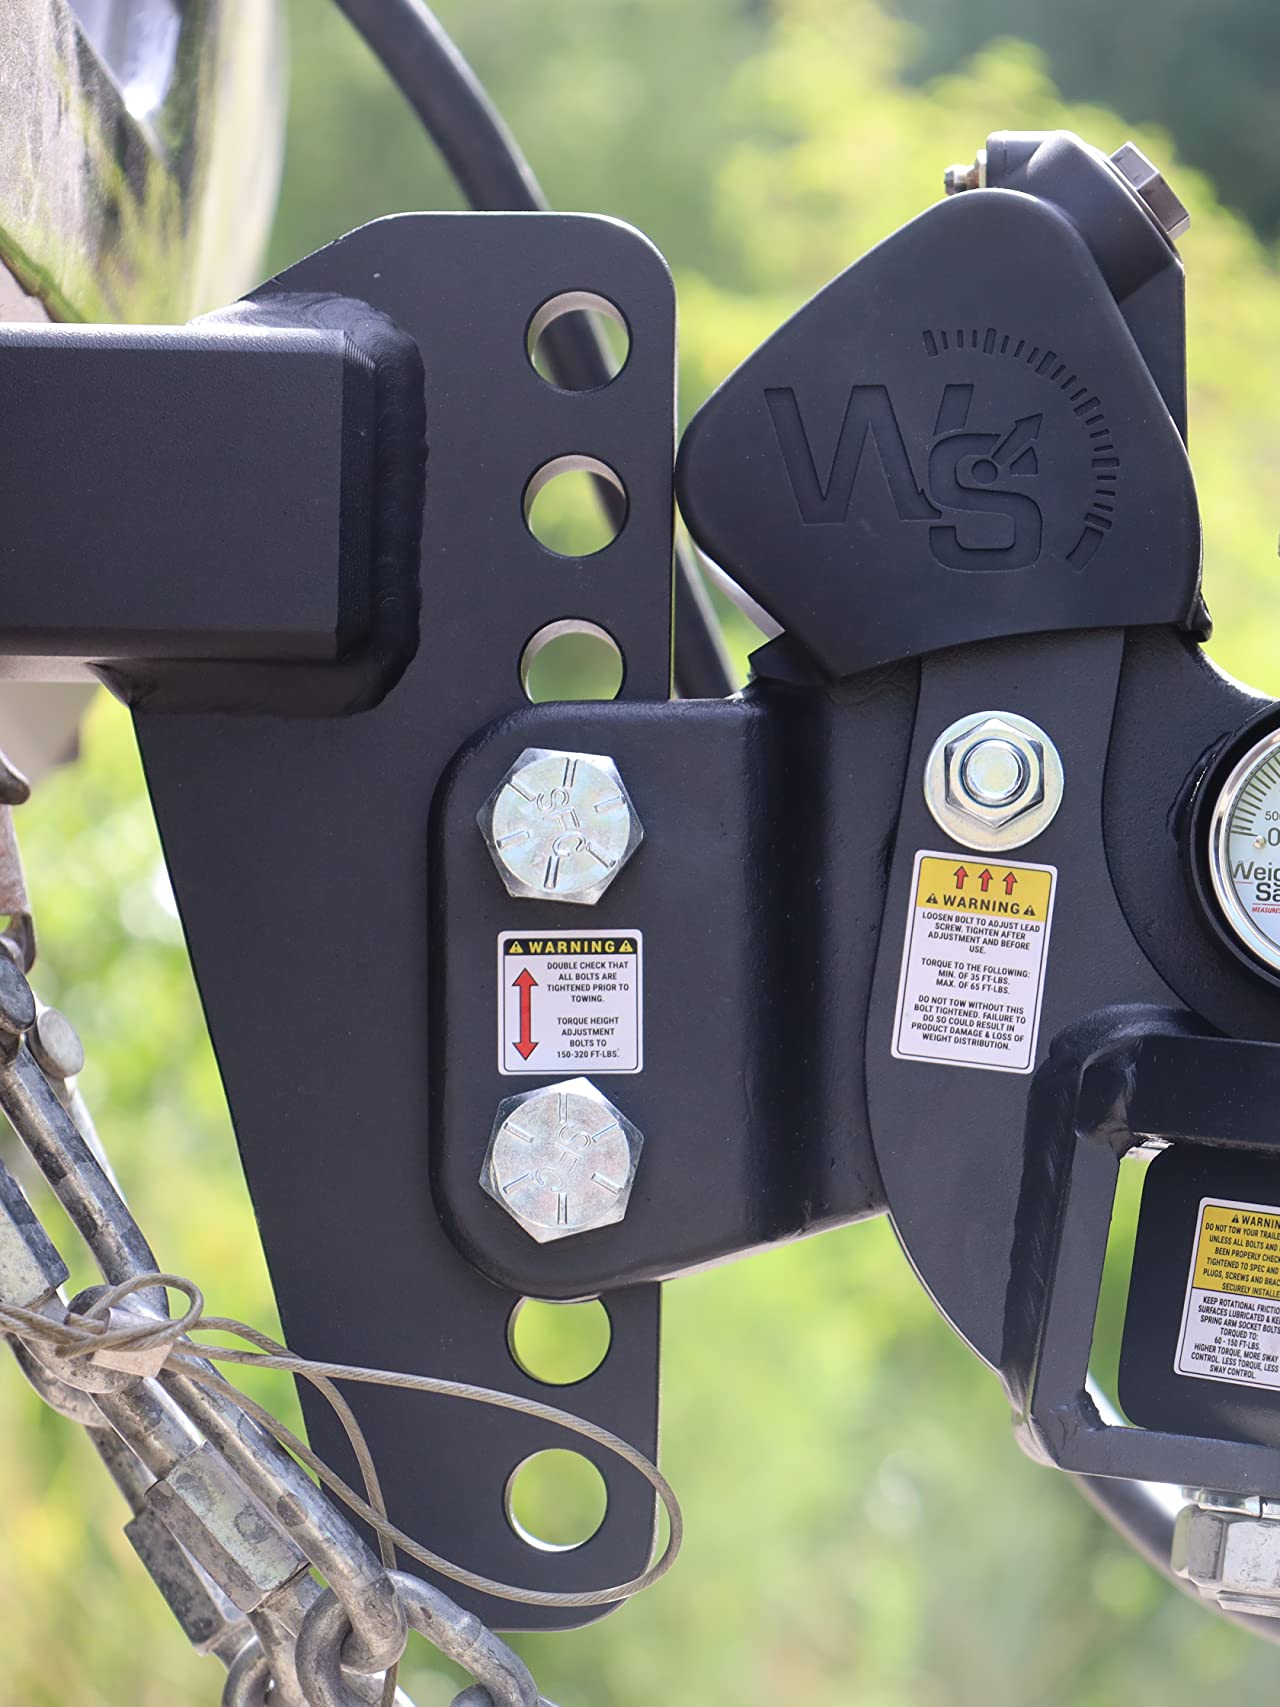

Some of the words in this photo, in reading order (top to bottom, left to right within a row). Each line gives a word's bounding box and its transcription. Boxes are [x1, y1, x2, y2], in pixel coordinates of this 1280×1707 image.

[1268, 828, 1280, 846] 0
[944, 895, 1020, 914] WARNING
[923, 912, 953, 922] LOOSEN
[955, 915, 974, 924] BOLT
[976, 918, 986, 926] TO
[988, 920, 1019, 930] ADJUST
[1021, 924, 1040, 932] LEAD
[966, 926, 999, 936] TIGHTEN
[1001, 931, 1025, 940] AFTER
[529, 941, 615, 953] WARNING
[928, 931, 981, 944] ADJUSTMENT
[982, 938, 999, 946] AND
[1001, 940, 1030, 950] BEFORE
[547, 962, 577, 970] DOUBLE
[922, 958, 952, 968] TORQUE
[955, 962, 964, 970] TO
[967, 963, 981, 972] THE
[971, 973, 979, 981] 35
[547, 984, 590, 992] TIGHTENED
[959, 981, 968, 989] OF
[919, 995, 929, 1003] DO
[931, 997, 947, 1005] NOT
[950, 999, 966, 1007] TOW
[969, 1001, 1004, 1012] WITHOUT
[1006, 1006, 1024, 1015] THIS
[557, 1017, 588, 1025] TORQUE
[914, 1004, 934, 1012] BOLT
[983, 1012, 1014, 1023] FAILURE
[1016, 1016, 1026, 1024] TO
[923, 1014, 934, 1022] DO
[936, 1016, 947, 1024] SO
[949, 1017, 974, 1027] COULD
[976, 1021, 1005, 1031] RESULT
[562, 1028, 614, 1036] ADJUSTMENT
[912, 1022, 948, 1033] PRODUCT
[950, 1027, 983, 1037] DAMAGE
[992, 1032, 1012, 1041] LOSS
[923, 1033, 952, 1043] WEIGHT
[570, 1039, 594, 1047] BOLTS
[596, 1039, 606, 1047] TO
[1206, 1223, 1214, 1231] DO
[1215, 1224, 1227, 1232] NOT
[1229, 1226, 1242, 1234] TOW
[1243, 1228, 1258, 1237] YOUR
[1209, 1235, 1232, 1245] UNLESS
[1233, 1239, 1243, 1247] ALL
[1245, 1240, 1264, 1249] BOLTS
[1265, 1243, 1278, 1251] AND
[1215, 1247, 1230, 1256] BEEN
[1231, 1249, 1261, 1260] PROPERLY
[1207, 1257, 1239, 1269] TIGHTENED
[1241, 1262, 1248, 1270] TO
[1250, 1264, 1265, 1273] SPEC
[1266, 1267, 1279, 1275] AND
[1225, 1272, 1249, 1282] SCREWS
[1251, 1276, 1263, 1284] AND
[1222, 1283, 1251, 1293] SECURELY
[1203, 1296, 1218, 1305] KEEP
[1219, 1298, 1255, 1311] ROTATIONAL
[1198, 1305, 1228, 1316] SURFACES
[1229, 1310, 1265, 1322] LUBRICATED
[1201, 1315, 1222, 1325] SPRING
[1224, 1319, 1237, 1327] ARM
[1238, 1321, 1262, 1331] SOCKET
[1263, 1325, 1280, 1334] BOLTS
[1221, 1327, 1247, 1339] TORQUED
[1215, 1336, 1222, 1344] 60
[1228, 1339, 1238, 1347] 150
[1194, 1343, 1216, 1353] HIGHER
[1244, 1351, 1261, 1360] MORE
[1262, 1354, 1279, 1362] SWAY
[1210, 1365, 1226, 1374] SWAY
[1222, 1357, 1237, 1366] LESS
[1264, 1364, 1279, 1373] LESS
